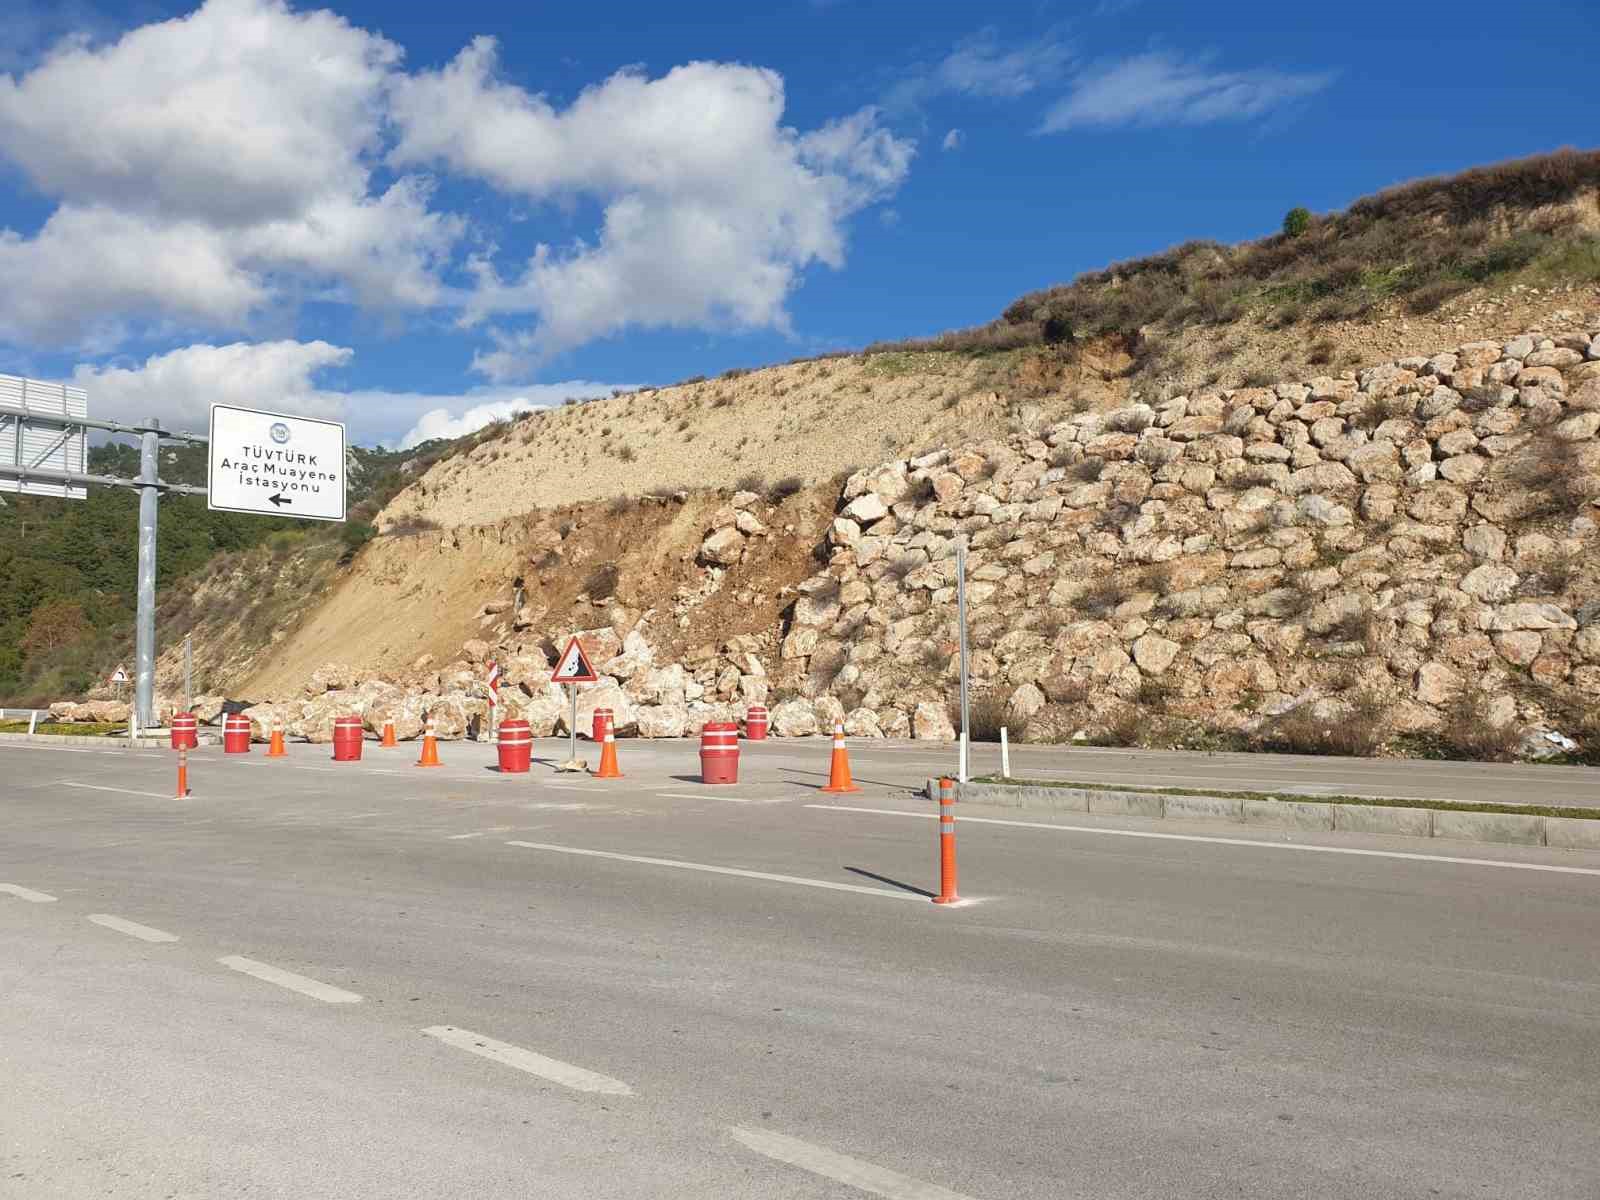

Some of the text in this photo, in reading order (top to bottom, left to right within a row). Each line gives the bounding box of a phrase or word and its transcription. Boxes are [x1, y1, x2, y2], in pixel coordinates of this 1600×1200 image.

[243, 445, 318, 466] TÜVTÜRK
[221, 458, 336, 482] Araç Muayene
[239, 471, 320, 493] İstasyonu
